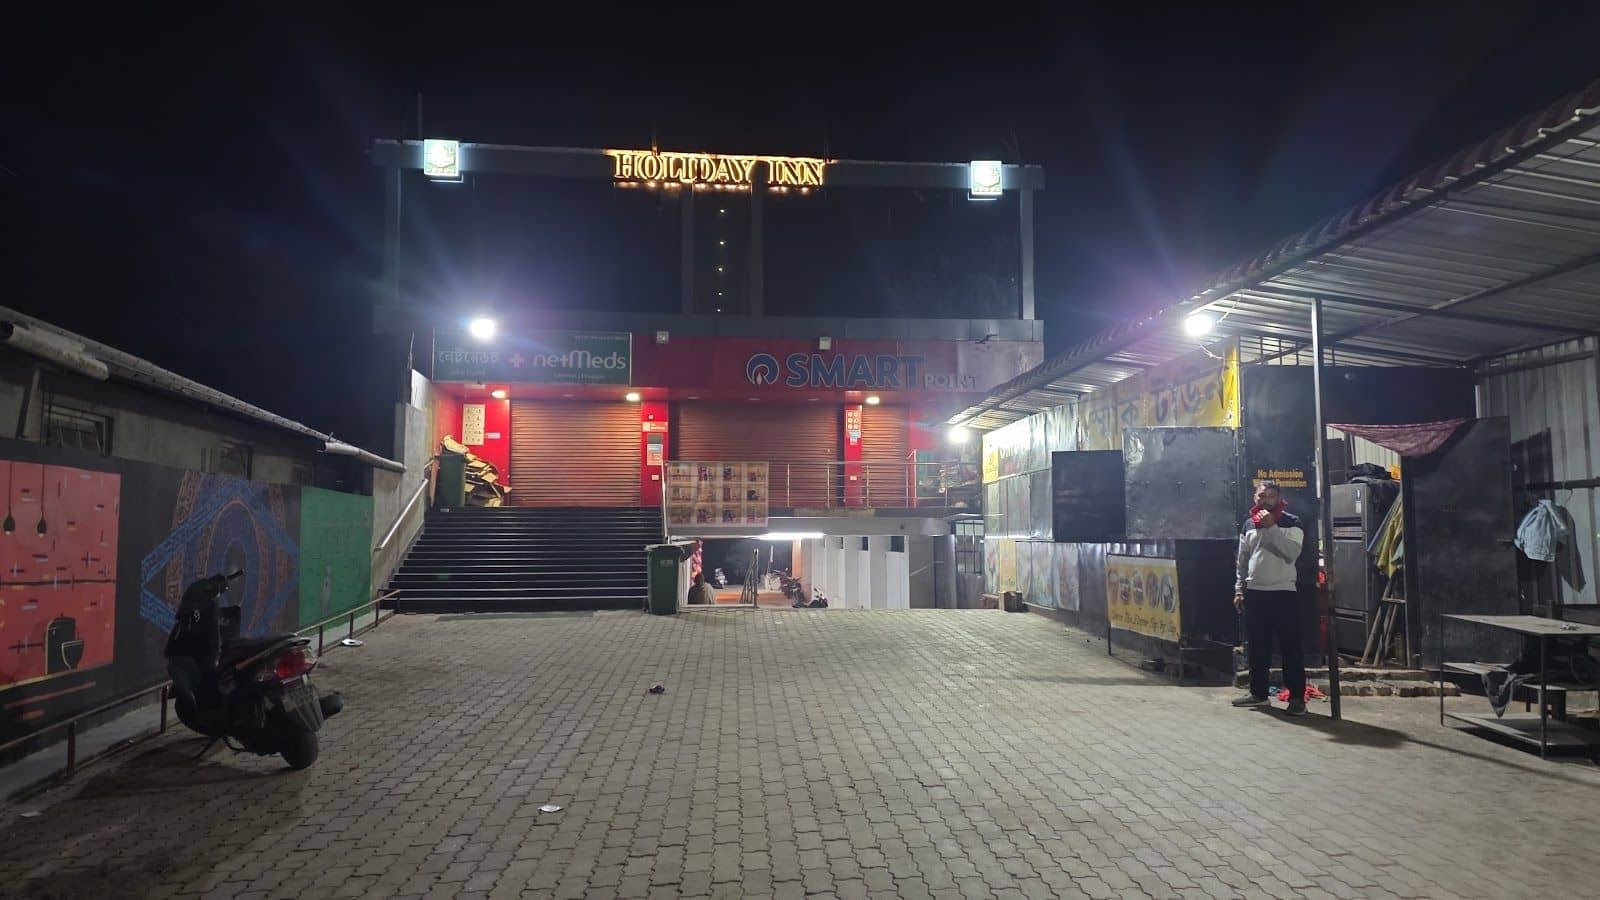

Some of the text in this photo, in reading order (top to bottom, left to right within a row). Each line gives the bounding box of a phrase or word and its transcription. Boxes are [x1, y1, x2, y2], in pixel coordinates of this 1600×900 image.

[613, 152, 825, 186] HOLIDAY INN
[533, 350, 627, 369] netMeds
[786, 353, 977, 390] SMART POINT
[1257, 469, 1304, 479] No Admission
